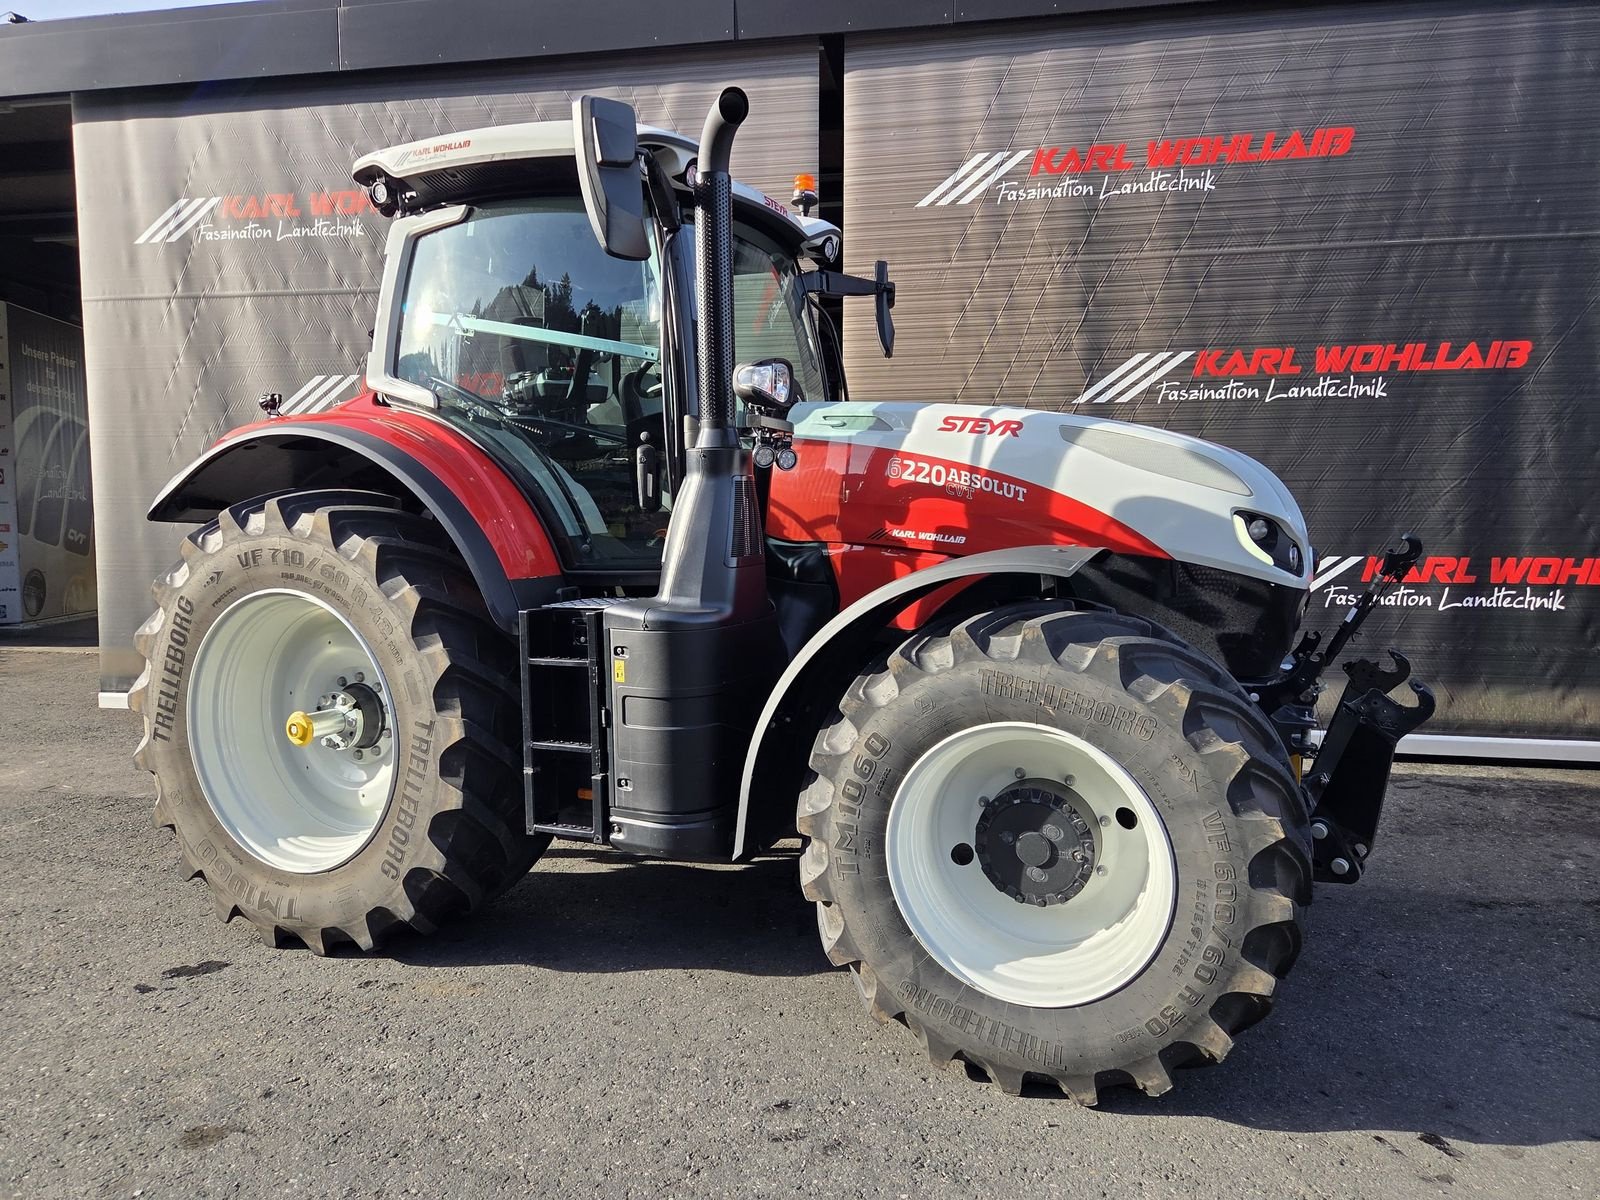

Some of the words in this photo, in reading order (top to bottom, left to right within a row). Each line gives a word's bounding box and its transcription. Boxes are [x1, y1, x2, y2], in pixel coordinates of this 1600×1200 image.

[1030, 144, 1135, 177] KARL
[996, 178, 1094, 205] Faszination
[1099, 168, 1216, 200] Landtechnik
[222, 192, 302, 220] KARL
[197, 223, 273, 244] Faszination
[276, 216, 366, 242] Landtechnik
[21, 343, 49, 361] Unsere
[1193, 346, 1302, 378] KARL
[1156, 378, 1259, 405] Faszination
[1264, 375, 1387, 403] Landtechnik
[937, 415, 1024, 438] STEYR
[887, 457, 946, 487] 6220
[946, 468, 1027, 502] ABSOLUT
[946, 482, 975, 500] CVT
[892, 528, 917, 539] KARL
[236, 548, 262, 569] VF
[1323, 584, 1432, 608] Fasnation
[1438, 586, 1565, 612] Landtechnik
[152, 594, 195, 744] TRELLEBORG
[977, 668, 1158, 742] TRELLEBORG
[380, 719, 436, 882] TRELLEBORG
[833, 730, 892, 882] TM1060
[1202, 810, 1232, 853] VF
[897, 979, 1067, 1072] TRELLEBORG
